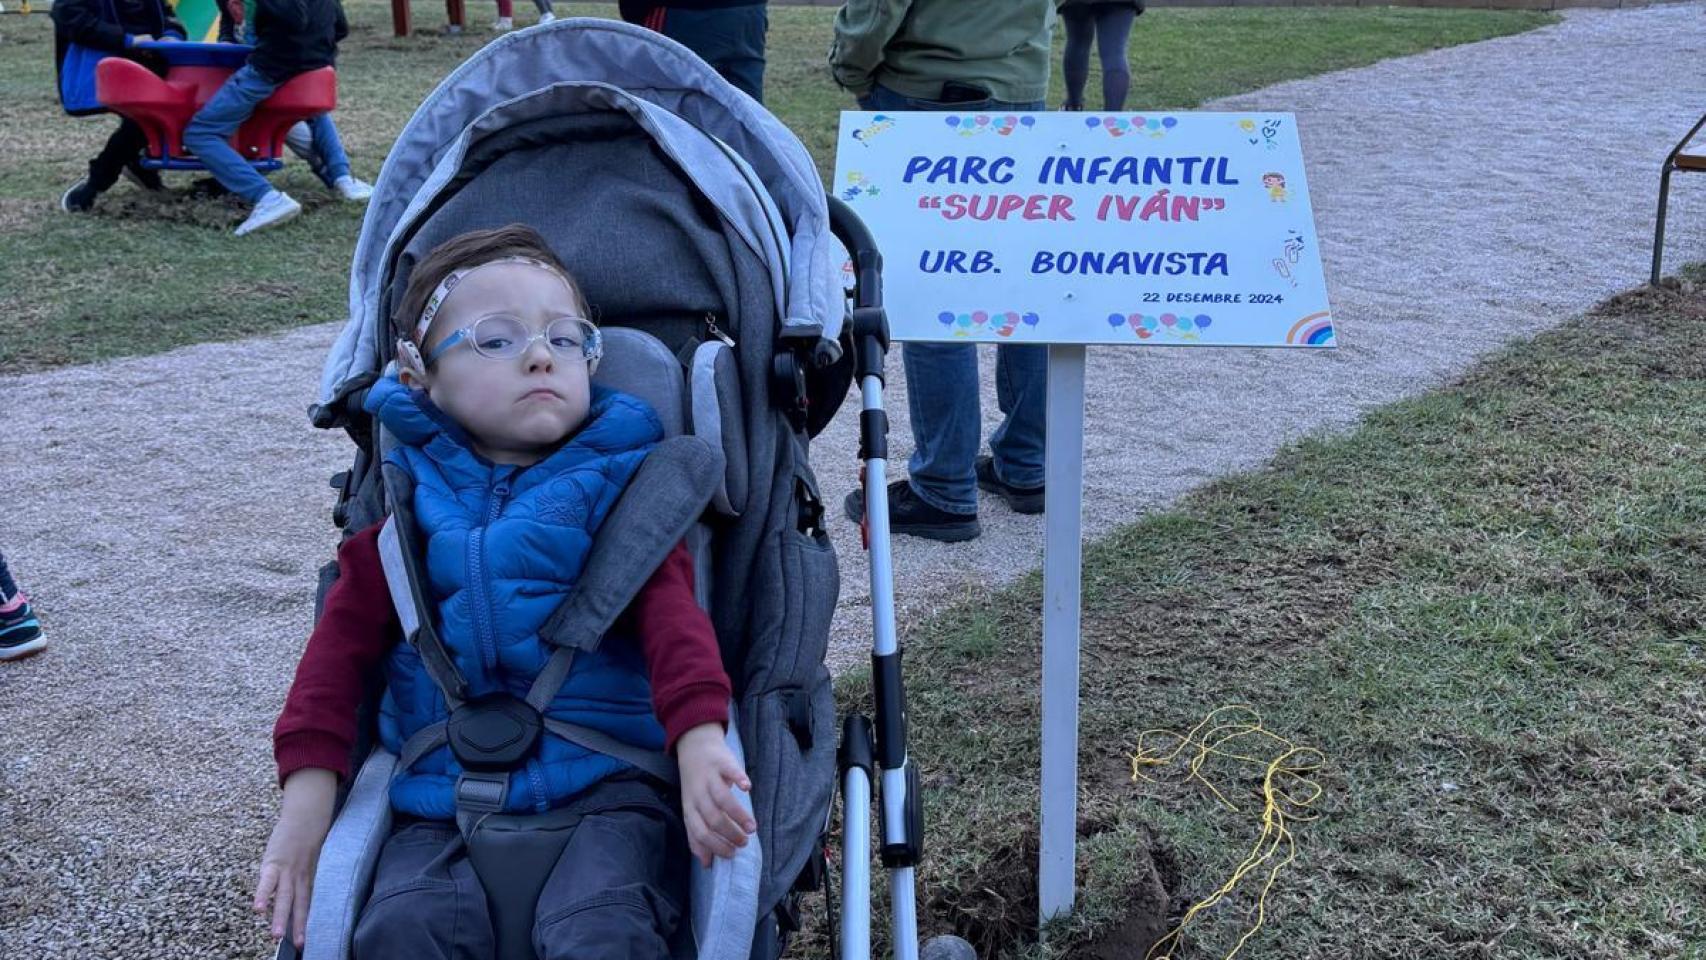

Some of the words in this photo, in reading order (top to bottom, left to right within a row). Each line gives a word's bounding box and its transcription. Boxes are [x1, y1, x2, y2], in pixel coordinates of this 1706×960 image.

[902, 156, 1016, 185] PARC
[1037, 156, 1240, 186] INFANTIL
[918, 194, 1076, 222] “SUPER
[1096, 189, 1226, 223] IVÁN”
[919, 249, 1002, 274] URB.
[1030, 250, 1230, 276] BONAVISTA
[1142, 292, 1161, 303] 22
[1166, 292, 1242, 304] DESEMBRE
[1248, 293, 1285, 304] 2024
